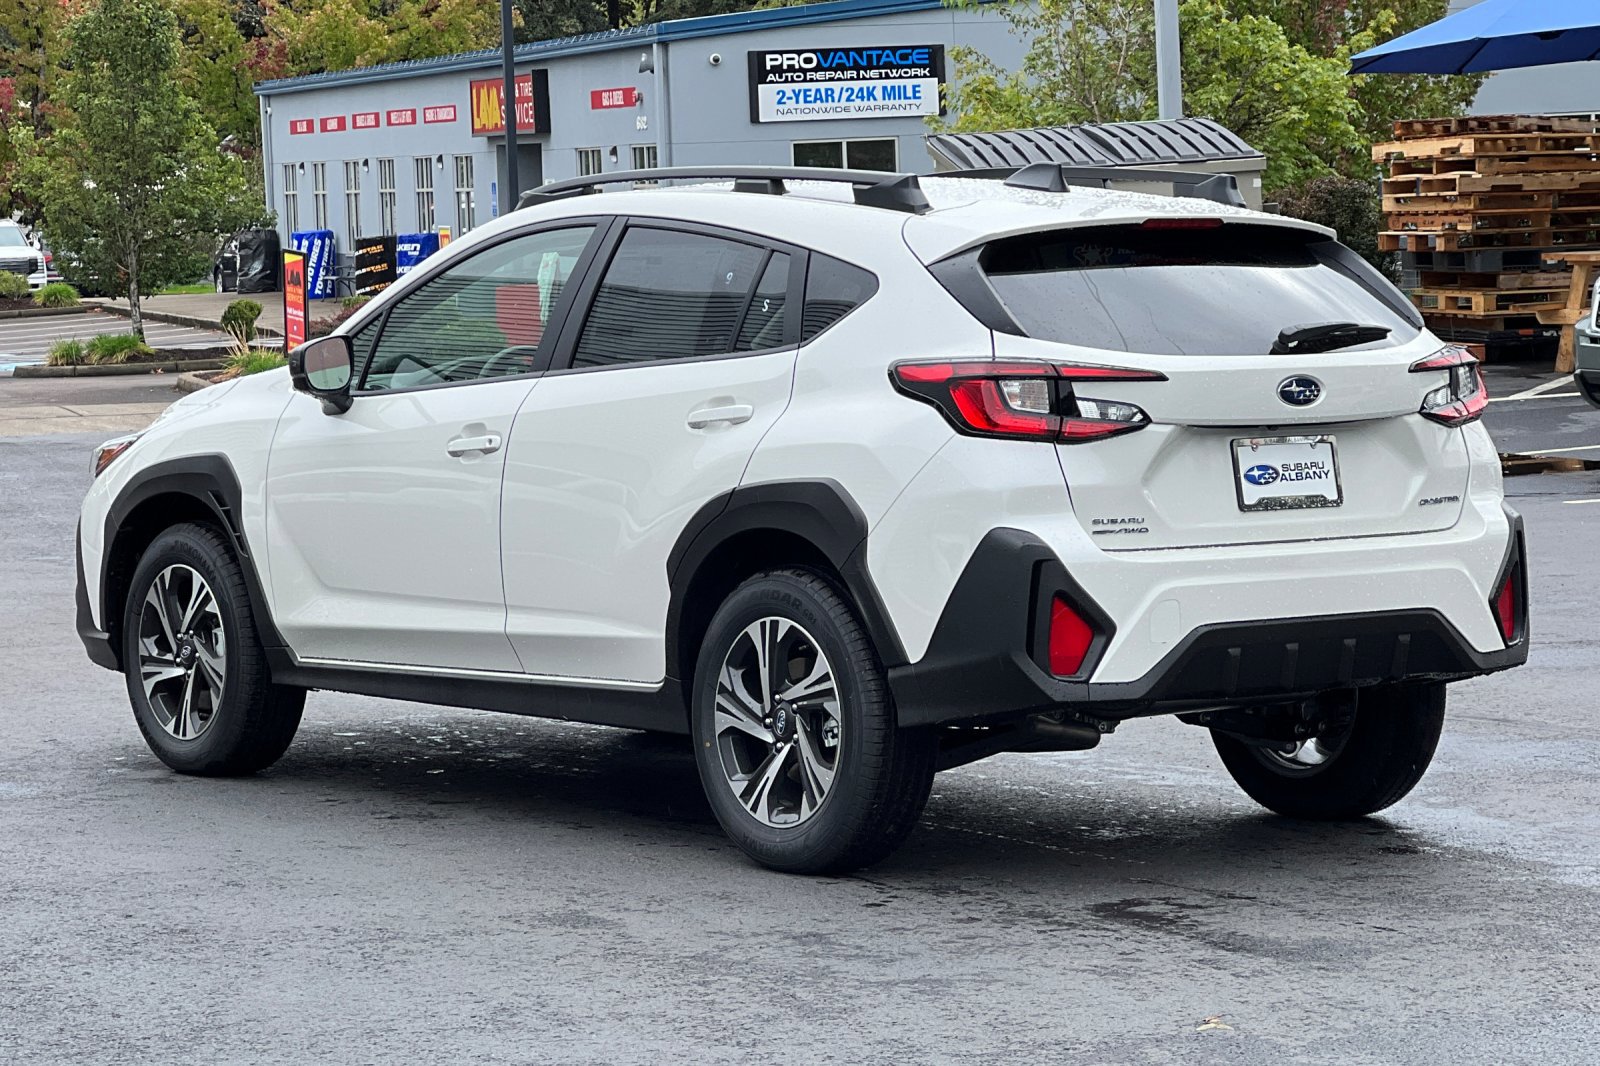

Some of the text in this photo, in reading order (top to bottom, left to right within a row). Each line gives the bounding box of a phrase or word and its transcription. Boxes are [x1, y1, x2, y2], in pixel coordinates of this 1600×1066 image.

[765, 48, 930, 70] PROVANTAGE
[766, 67, 930, 82] AUTO REPAIR NETWORK
[520, 82, 533, 96] TIRE
[882, 84, 922, 101] MILE
[472, 83, 501, 130] LAVA
[776, 106, 851, 116] NATIONWIDE
[853, 103, 922, 112] WARRANTY
[501, 103, 534, 125] SVICE
[1281, 461, 1325, 472] SUBARU
[1280, 470, 1330, 482] ALBANY
[1091, 517, 1145, 525] SUBARU
